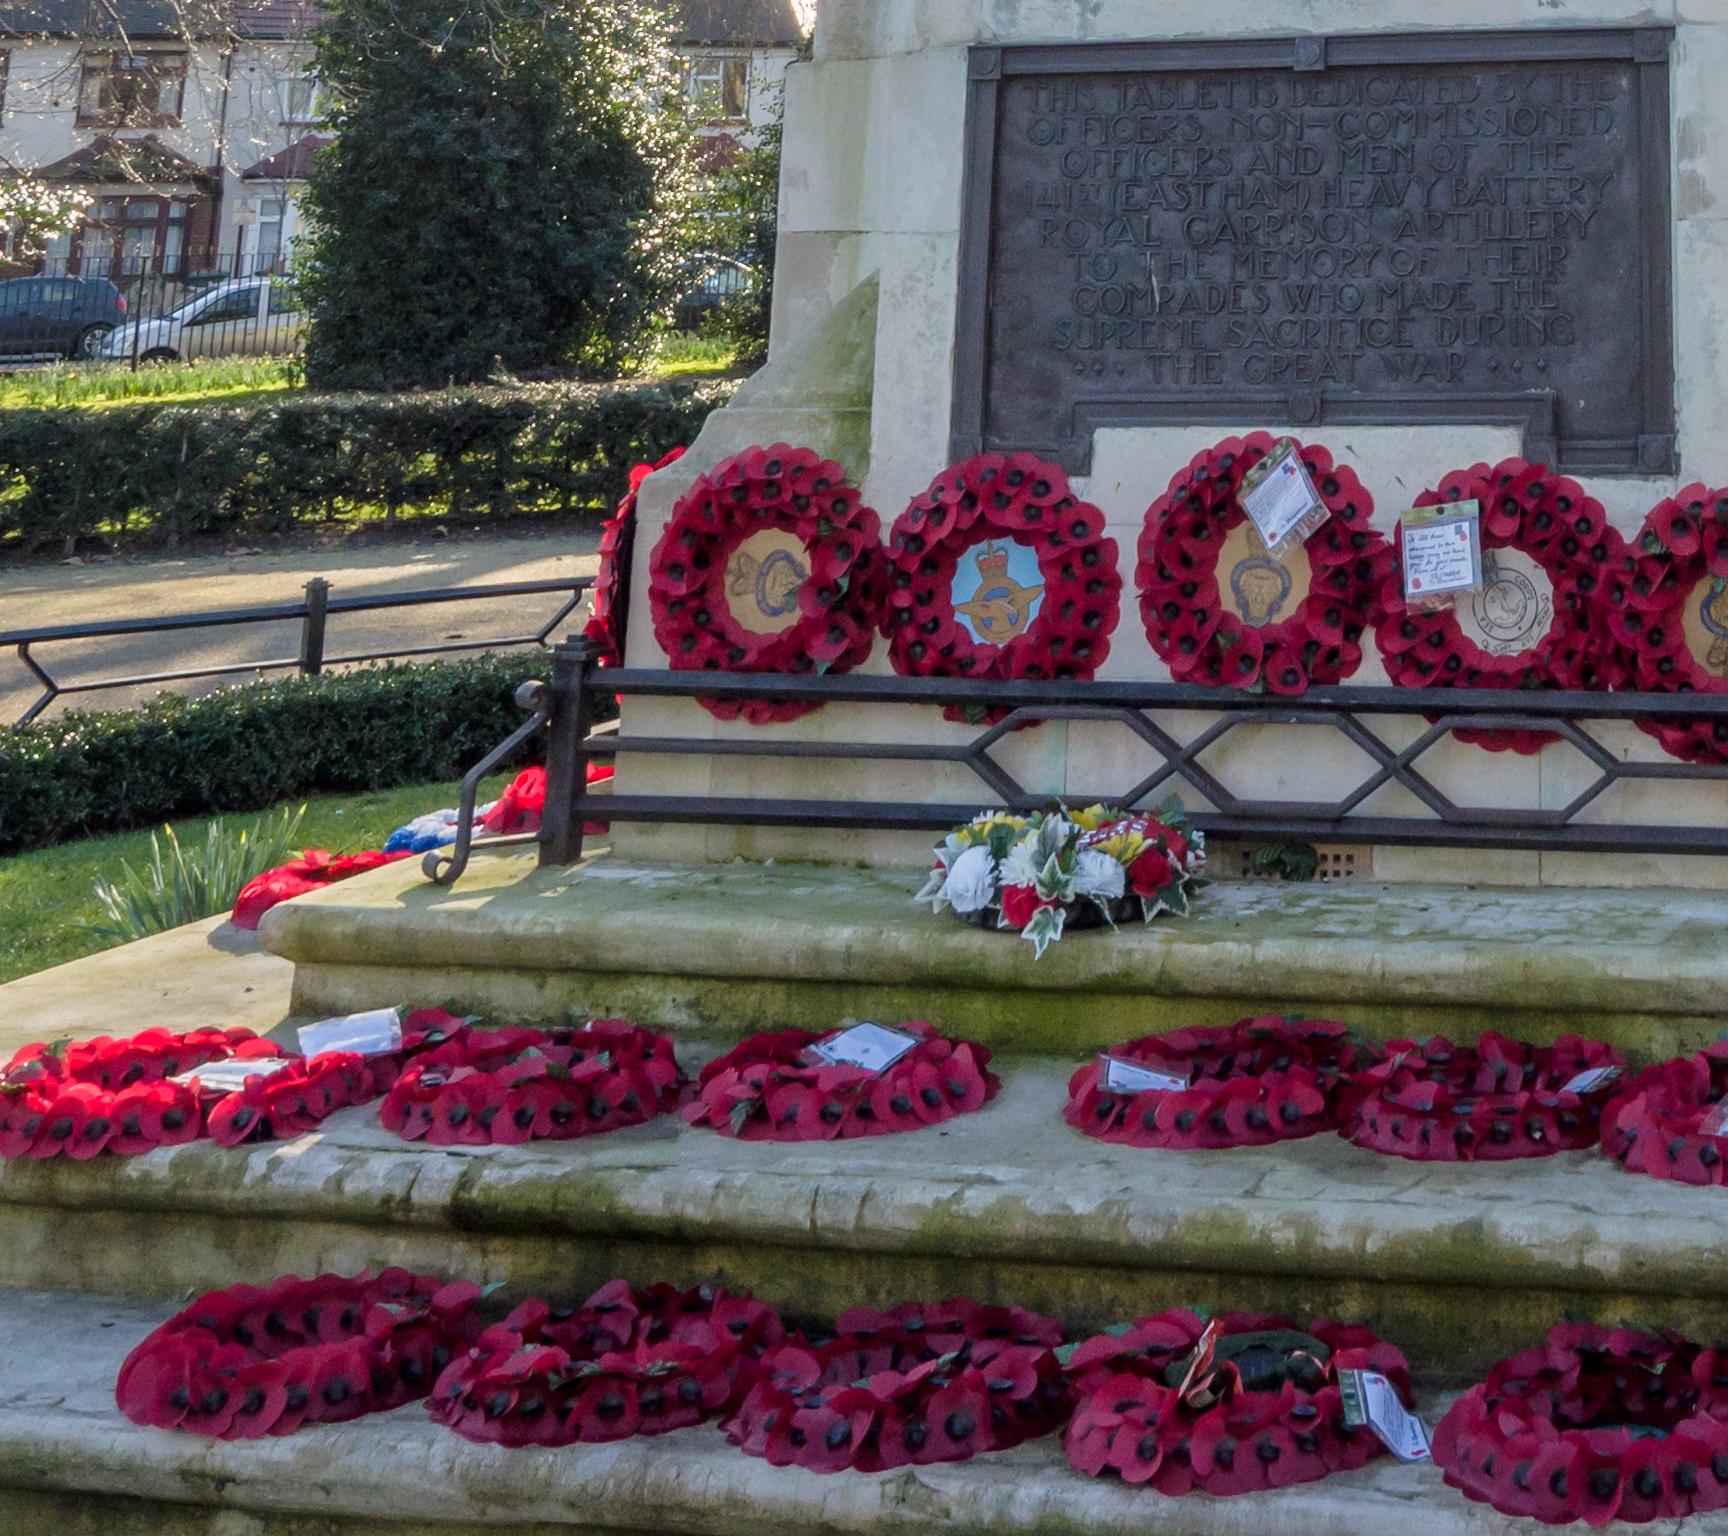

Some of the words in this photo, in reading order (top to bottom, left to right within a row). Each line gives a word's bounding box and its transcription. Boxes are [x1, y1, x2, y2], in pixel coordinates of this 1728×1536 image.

[1024, 79, 1096, 113] THIS
[1112, 77, 1241, 111] TABLET
[1251, 77, 1279, 109] IS
[1289, 74, 1481, 108] DEDICATED
[1496, 71, 1537, 104] BY
[1549, 70, 1617, 102] THE
[1061, 147, 1233, 179] OFFICERS
[1247, 144, 1323, 176] AND
[1338, 142, 1415, 176] MEN
[1430, 142, 1478, 174] OF
[1498, 140, 1575, 172] THE
[1322, 175, 1441, 209] HEAVY
[1452, 172, 1615, 207] BATTERY
[1040, 214, 1162, 249] ROYAL
[1394, 208, 1597, 244] ARTILLERY
[1067, 250, 1118, 282] TO
[1137, 248, 1214, 281] THE
[1229, 245, 1382, 281] MEMORY
[1387, 245, 1438, 278] OF
[1455, 243, 1569, 276] THEIR
[1071, 282, 1271, 317] COMRADES
[1284, 281, 1365, 315] WHO
[1376, 280, 1476, 312] MADE
[1490, 278, 1559, 311] THE
[1051, 318, 1208, 351] SUPREME
[1226, 314, 1417, 349] SACRIFICE
[1434, 313, 1576, 347] DURING
[1147, 351, 1224, 385] THE
[1241, 351, 1363, 385] GREAT
[1380, 351, 1468, 384] WAR
